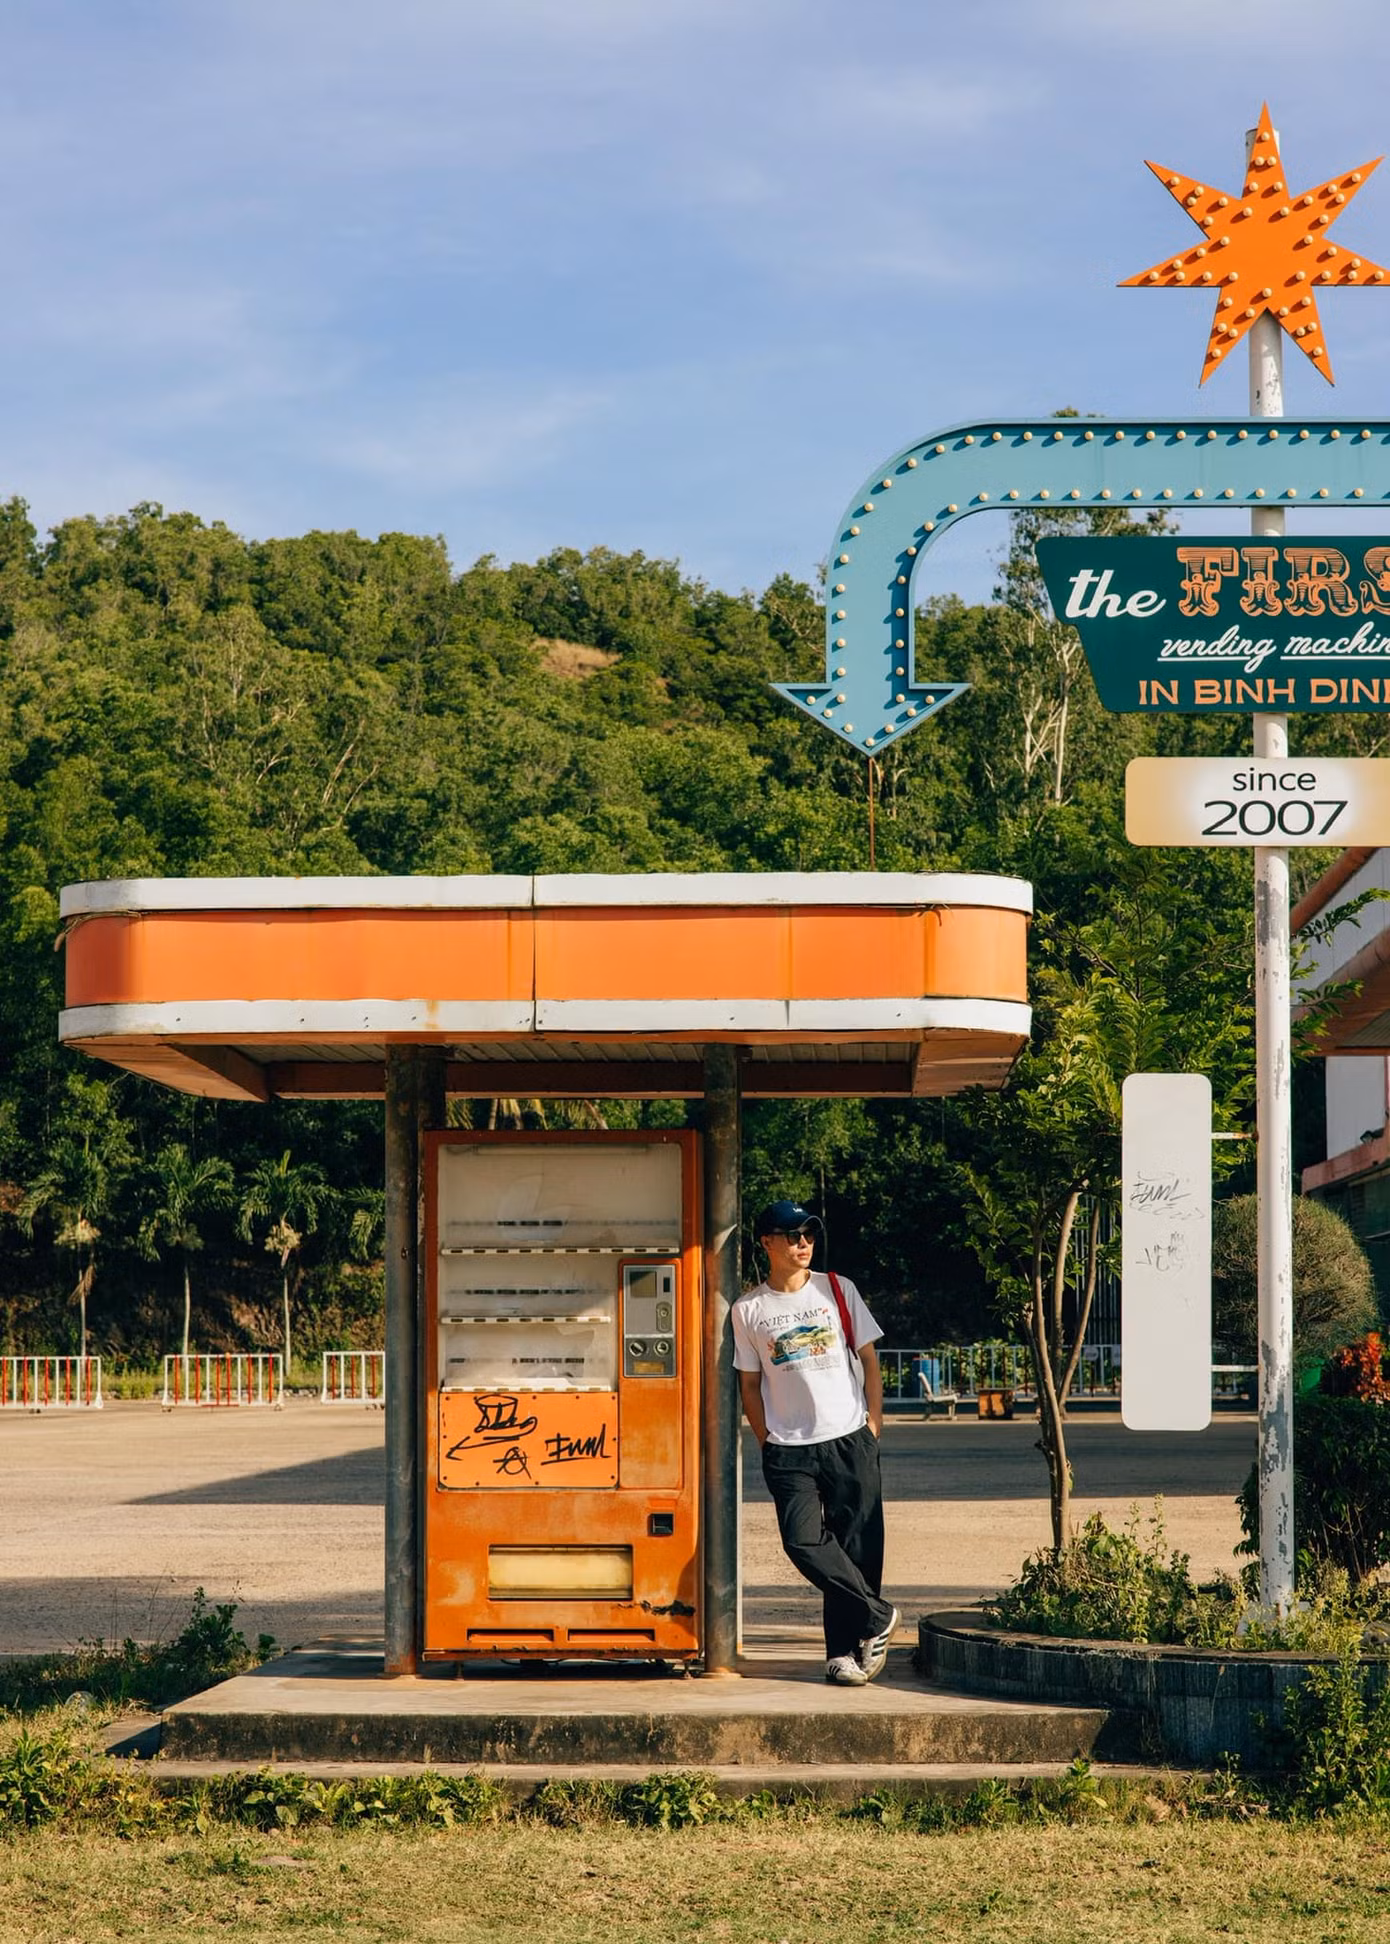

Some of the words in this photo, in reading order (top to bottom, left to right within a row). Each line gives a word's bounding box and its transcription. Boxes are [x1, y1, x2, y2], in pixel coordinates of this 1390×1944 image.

[1065, 569, 1166, 618] the
[1160, 624, 1277, 673] vending
[1139, 679, 1179, 704] IN
[1194, 678, 1296, 705] BINH
[1309, 678, 1390, 704] DIN
[1232, 767, 1317, 791] since
[1201, 800, 1349, 836] 2007
